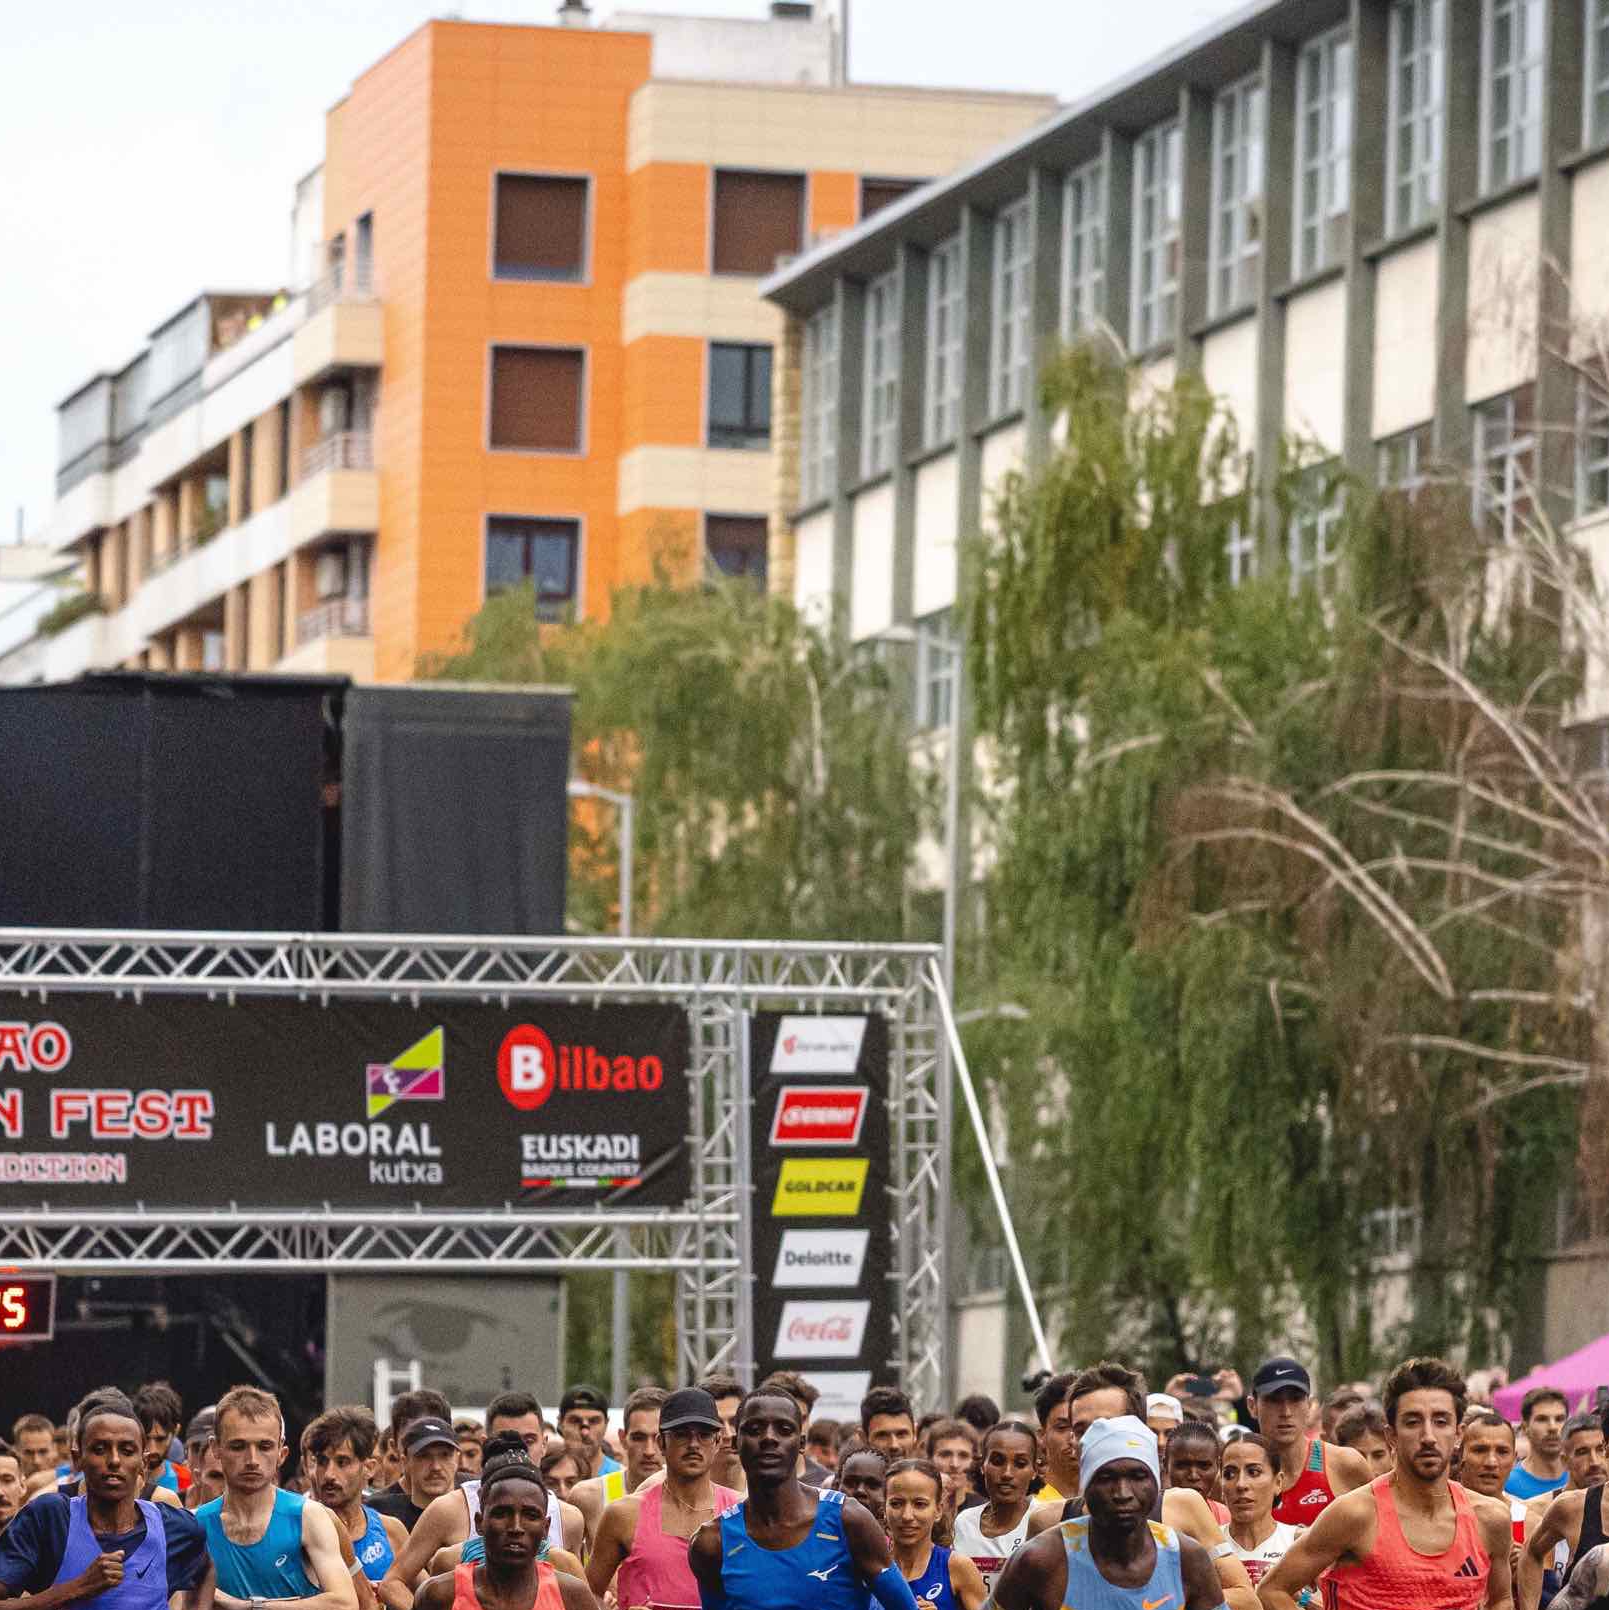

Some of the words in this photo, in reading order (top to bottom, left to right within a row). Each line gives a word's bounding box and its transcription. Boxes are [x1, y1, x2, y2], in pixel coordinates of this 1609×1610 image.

[509, 1042, 663, 1092] Bilbao
[51, 1089, 214, 1140] FEST
[266, 1122, 441, 1156] LABORAL
[520, 1133, 640, 1160] EUSKADI
[369, 1158, 444, 1185] kutxa
